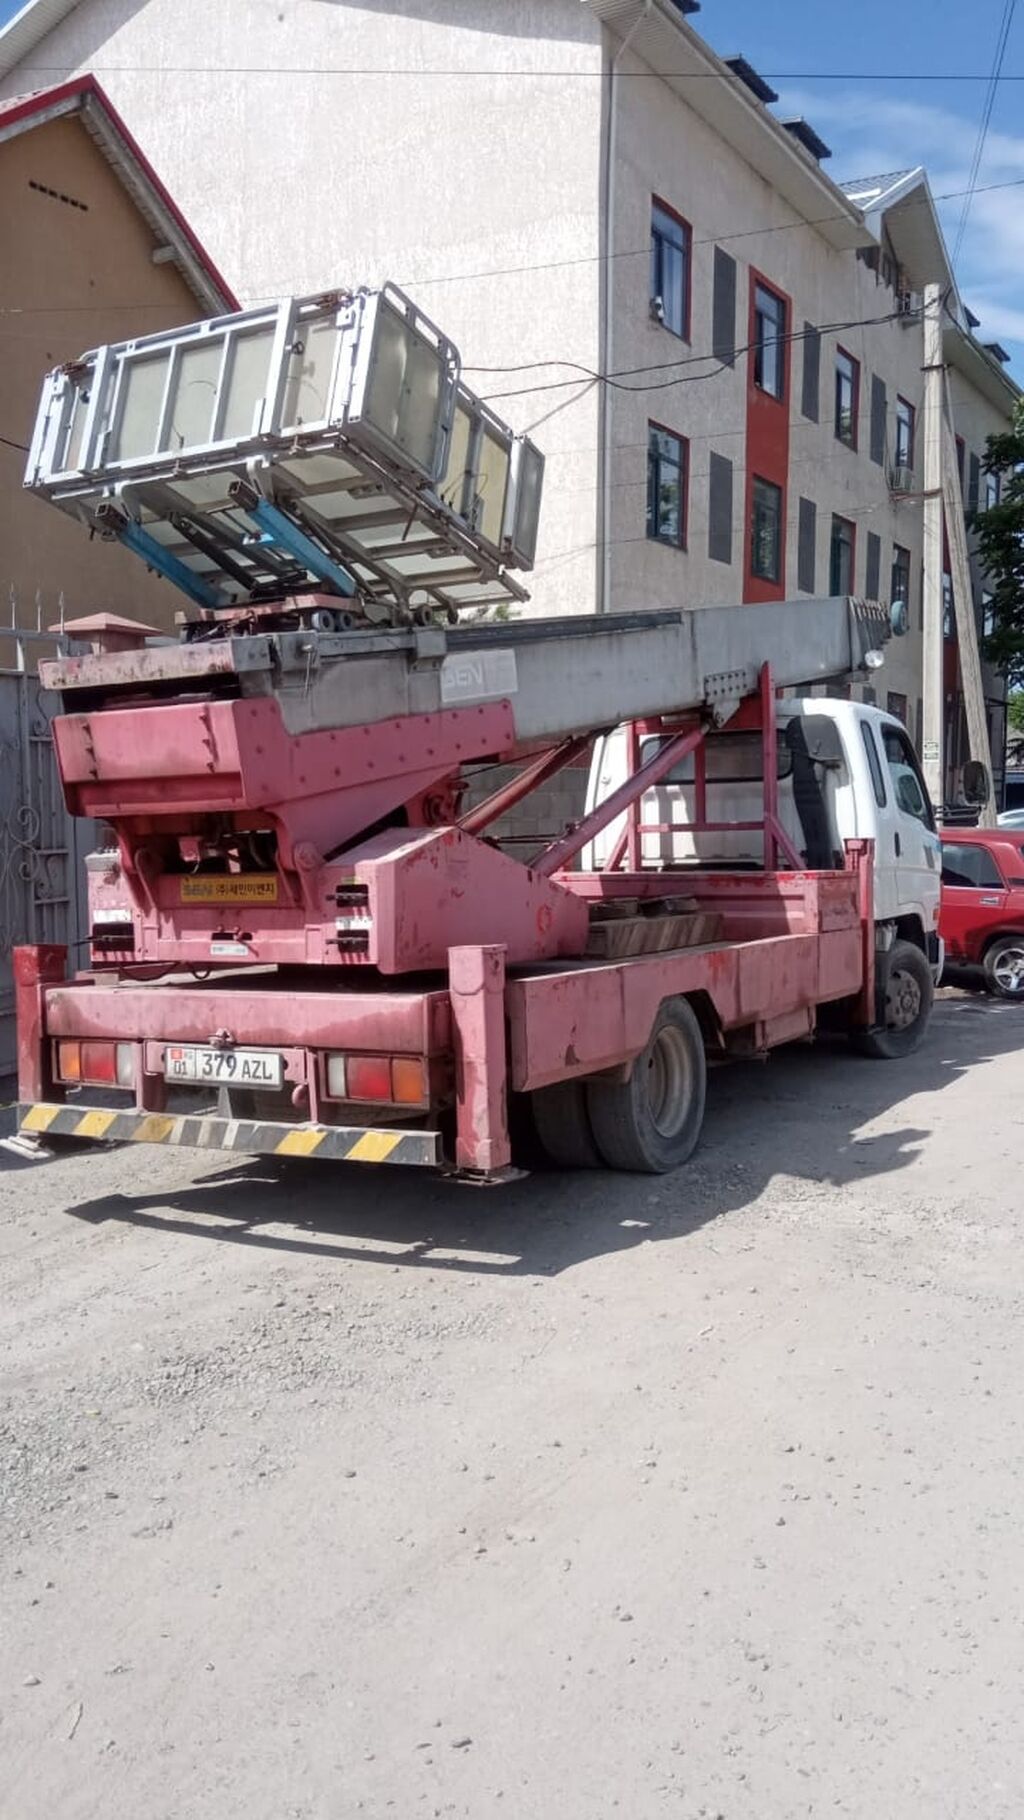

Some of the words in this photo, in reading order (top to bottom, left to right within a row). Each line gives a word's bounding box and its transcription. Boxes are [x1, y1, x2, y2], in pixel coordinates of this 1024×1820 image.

[174, 1060, 188, 1075] 01
[202, 1053, 237, 1078] 379
[241, 1060, 273, 1080] AZL
